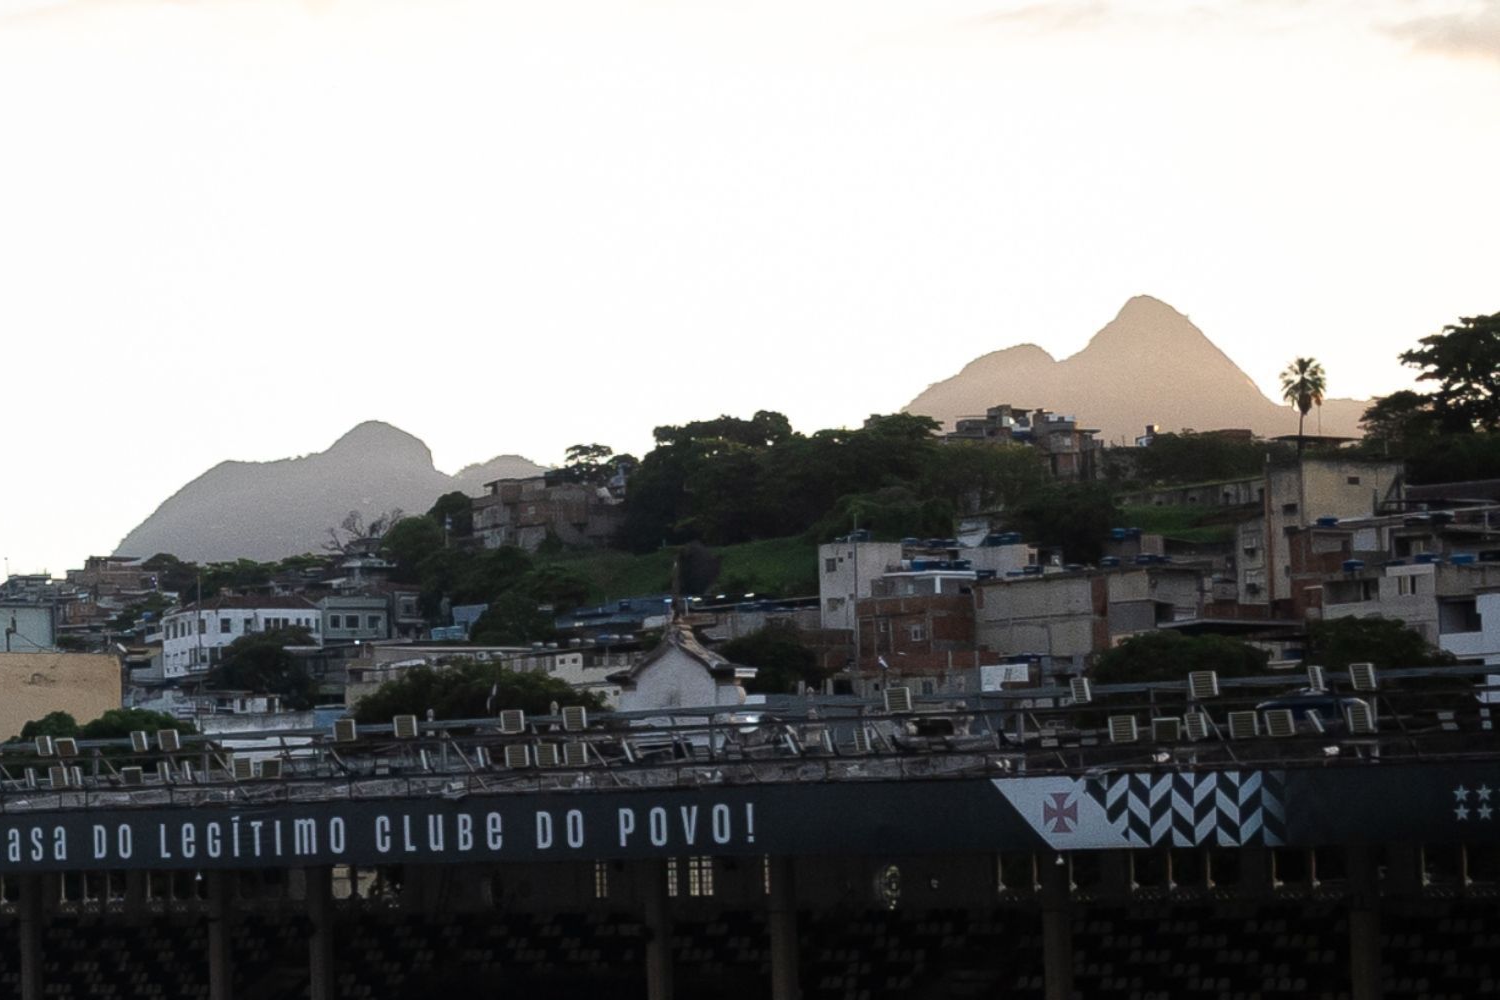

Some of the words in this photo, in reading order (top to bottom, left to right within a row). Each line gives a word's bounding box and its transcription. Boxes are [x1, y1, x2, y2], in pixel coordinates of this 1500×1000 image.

[93, 823, 133, 859] DO
[536, 809, 584, 849] DO
[618, 802, 755, 847] POVO!
